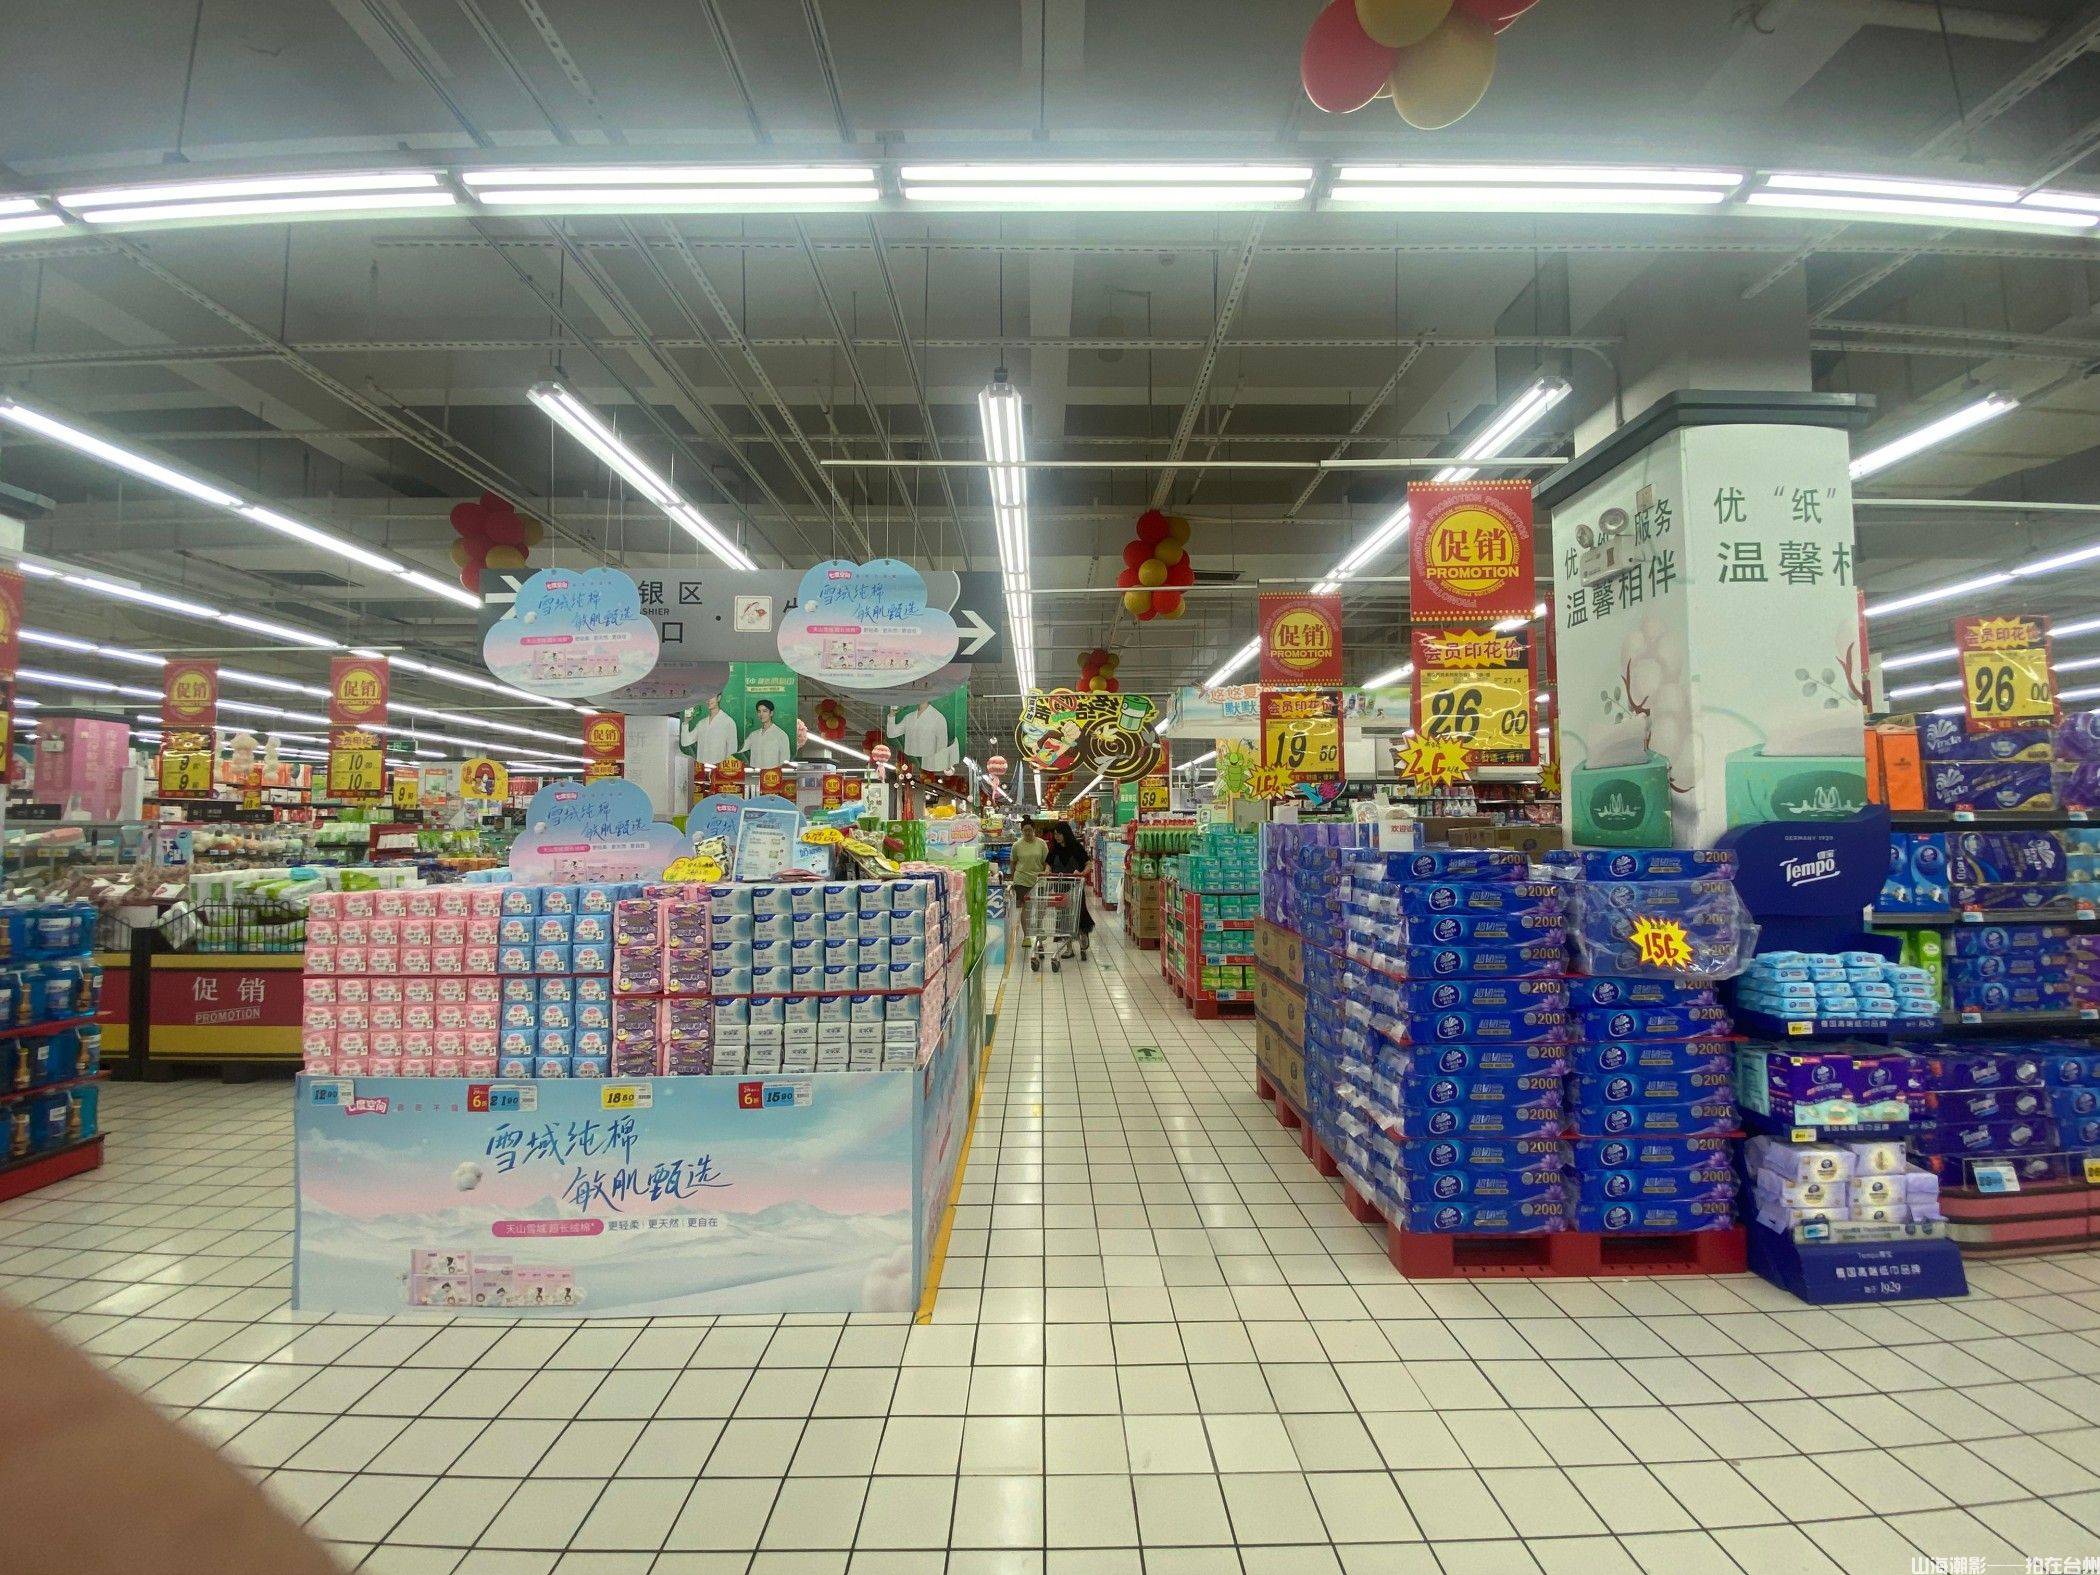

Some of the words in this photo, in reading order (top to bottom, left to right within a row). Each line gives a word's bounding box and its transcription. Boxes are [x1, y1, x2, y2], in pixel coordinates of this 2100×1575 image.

[1714, 487, 1747, 524] 优
[1438, 528, 1506, 562] 促销
[1565, 548, 1579, 580] 优
[1634, 499, 1672, 546] 服务
[1427, 566, 1519, 579] PROMOTION
[638, 580, 703, 606] 银区
[820, 583, 885, 606] 雪域纯棉
[1567, 550, 1676, 629] 温馨相伴
[538, 592, 600, 615] 雪域纯棉
[640, 607, 670, 616] SHIER
[854, 602, 923, 624] 敏肌甄选
[662, 622, 683, 643] 口
[1279, 624, 1324, 647] 促销
[1270, 649, 1332, 659] PROMOTION
[1425, 641, 1522, 662] 会员印花价
[177, 682, 207, 699] 促销
[345, 680, 375, 697] 促销
[1975, 666, 2015, 712] 26
[2031, 682, 2049, 700] 00
[1428, 688, 1482, 743] 26
[1502, 710, 1529, 735] 00
[594, 730, 617, 742] 促销
[1276, 731, 1307, 768] 19
[1142, 792, 1156, 806] 59
[548, 801, 612, 826] 雪域纯棉
[1706, 852, 1731, 863] 200
[1780, 857, 1835, 882] Tempo
[192, 976, 266, 1003] 促销
[195, 1007, 261, 1025] PROMOTION
[1704, 1074, 1728, 1085] 200
[607, 1092, 622, 1104] 18
[767, 1090, 781, 1102] 15
[486, 1115, 638, 1173] 雪域纯棉
[562, 1154, 734, 1212] 敏肌甄选
[608, 1220, 639, 1231] 更轻柔
[648, 1218, 679, 1229] 更天然
[687, 1217, 718, 1228] 更自在
[1880, 1282, 1901, 1294] 1929
